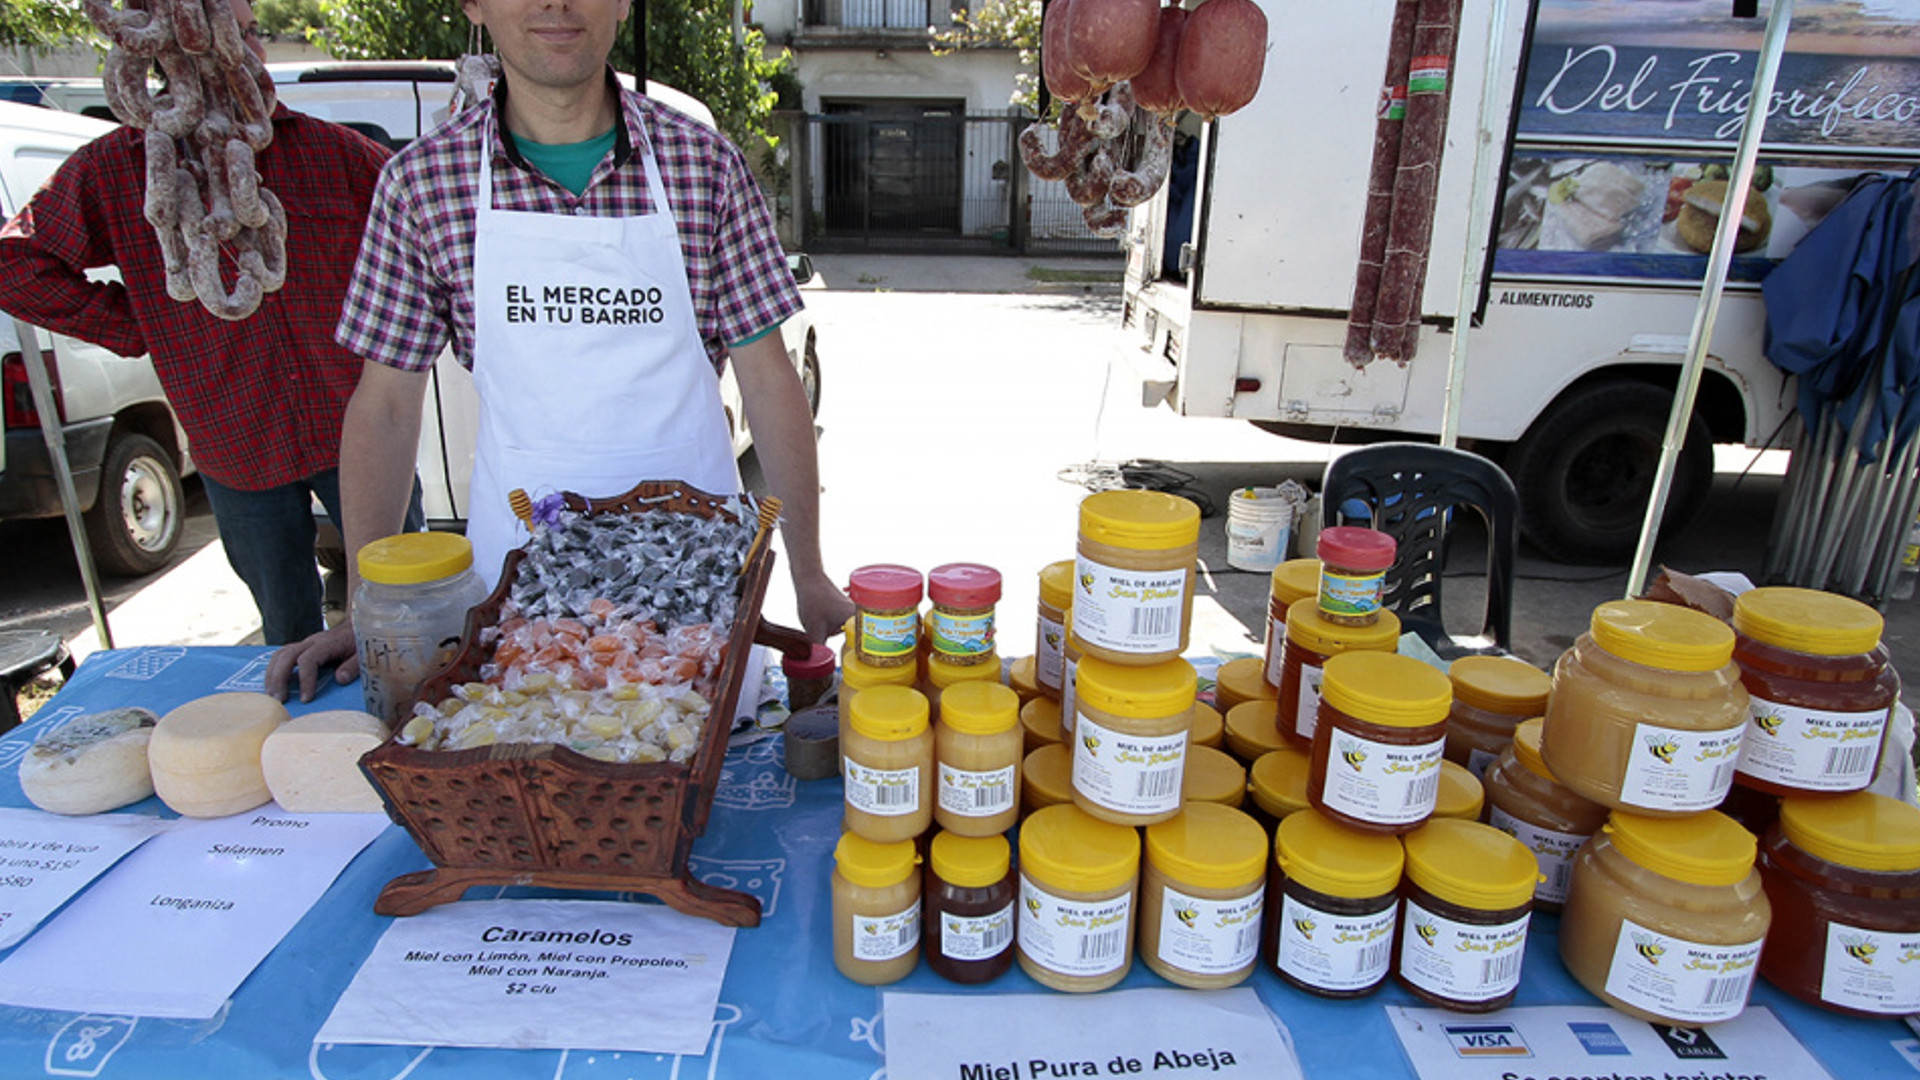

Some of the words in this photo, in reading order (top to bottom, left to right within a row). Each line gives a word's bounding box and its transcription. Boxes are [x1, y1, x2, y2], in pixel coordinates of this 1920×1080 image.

[1536, 45, 1658, 114] Del
[507, 285, 535, 303] EL
[543, 286, 662, 306] MERCADO
[1500, 291, 1595, 309] ALIMENTICIOS
[507, 306, 536, 323] EN
[543, 306, 573, 323] TU
[580, 307, 664, 325] BARRIO
[1109, 576, 1132, 587] MIEL
[1134, 580, 1147, 588] DE
[1805, 717, 1832, 728] MIEL
[1117, 741, 1139, 752] MIEL
[1386, 753, 1409, 762] MIEL
[251, 815, 310, 829] Promo
[1532, 833, 1555, 846] MIEL
[208, 843, 285, 857] Salamen
[150, 894, 236, 911] Longaniza
[1057, 905, 1079, 916] MIEL
[1082, 909, 1094, 917] DE
[1216, 907, 1238, 915] MIEL
[1334, 923, 1358, 932] MIEL
[481, 926, 634, 946] Caramelos
[1457, 930, 1482, 941] MIEL
[404, 951, 439, 962] Miel
[442, 954, 472, 962] con
[477, 951, 531, 962] Limón,
[538, 952, 572, 962] Miel
[576, 954, 606, 964] con
[1687, 948, 1713, 961] MIEL
[1716, 953, 1729, 961] DE
[468, 965, 503, 976] Miel
[507, 967, 537, 976] con
[542, 966, 610, 980] Naranja.
[505, 982, 527, 995] $2
[530, 984, 556, 994] c/u
[1463, 1034, 1511, 1047] VISA
[959, 1061, 1019, 1080] Miel
[1029, 1059, 1098, 1079] Pura
[1107, 1056, 1142, 1075] de
[1153, 1048, 1236, 1071] Abeja
